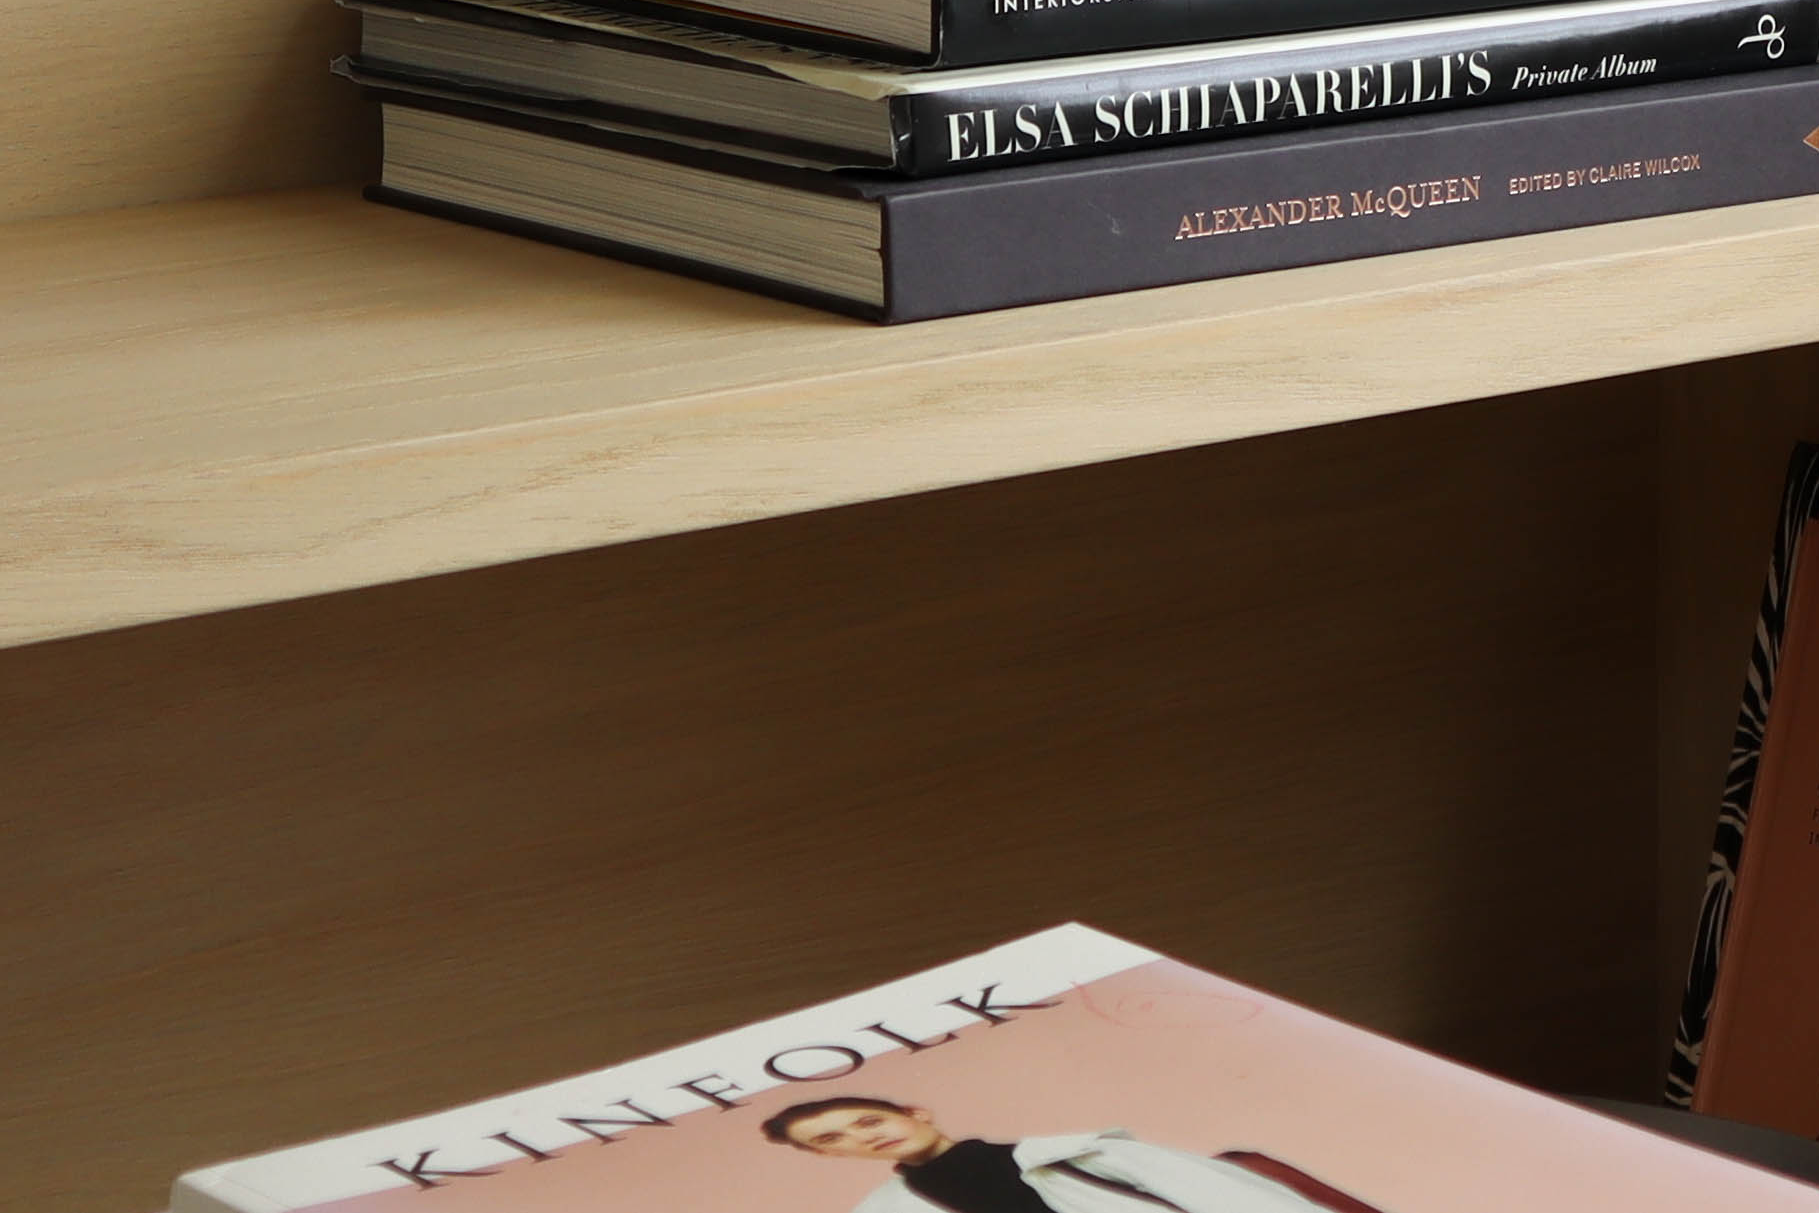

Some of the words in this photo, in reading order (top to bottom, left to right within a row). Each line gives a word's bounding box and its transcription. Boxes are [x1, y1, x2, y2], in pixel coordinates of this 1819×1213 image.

[947, 105, 1075, 162] ELSA
[1511, 64, 1589, 90] Private
[1591, 53, 1657, 80] Album
[1174, 195, 1345, 241] ALEXANDER
[1350, 175, 1482, 219] McQUEEN
[1508, 172, 1563, 196] EDITED
[1566, 168, 1586, 188] BY
[1588, 161, 1642, 185] CLAIRE
[1644, 153, 1701, 177] WILCOX
[367, 983, 1066, 1191] KINFOLK
